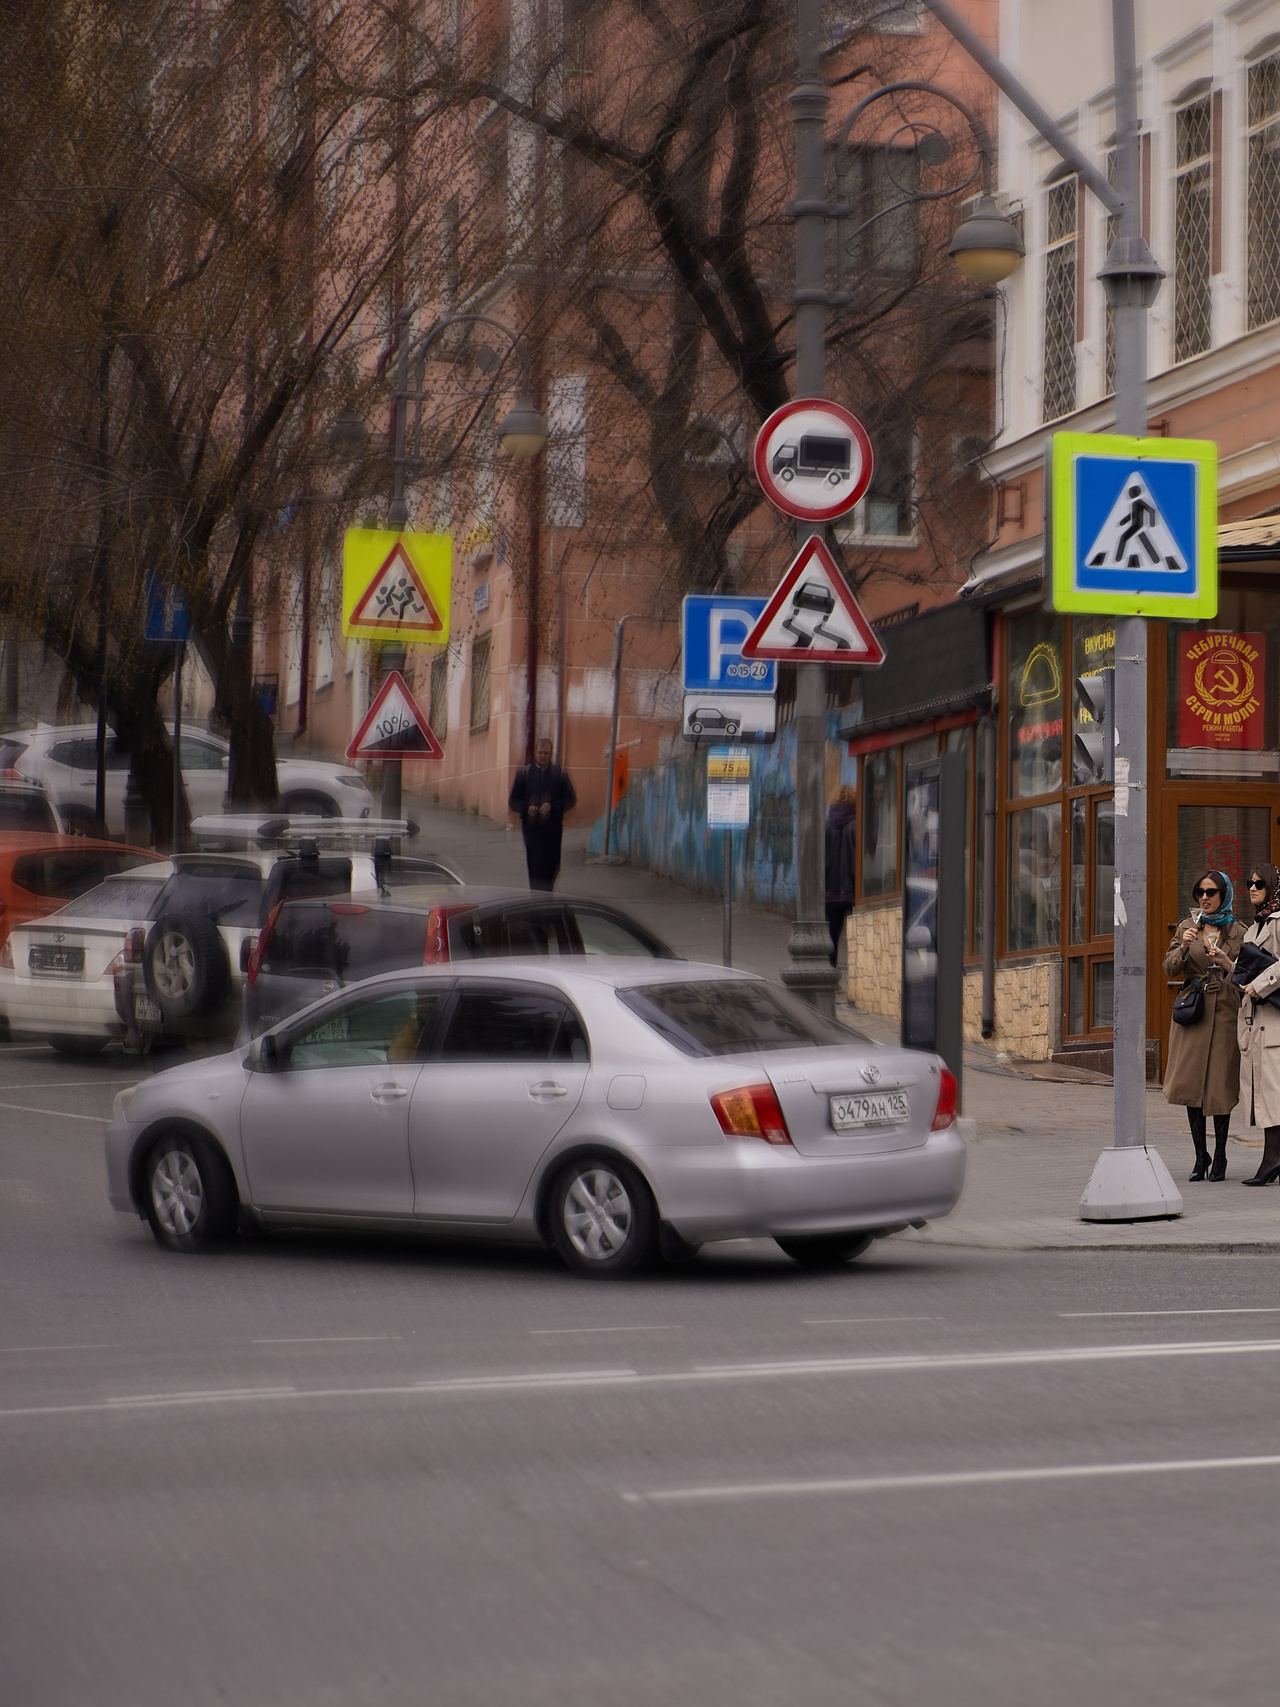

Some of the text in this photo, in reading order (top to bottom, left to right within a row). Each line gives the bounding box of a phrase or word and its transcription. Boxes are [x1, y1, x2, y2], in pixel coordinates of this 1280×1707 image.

[1186, 634, 1259, 662] ЧЕБУРЕЧНАЯ
[729, 665, 767, 677] 10 15 20
[1185, 695, 1260, 725] СЕРП И МОЛОТ
[376, 713, 409, 738] 10%
[1202, 724, 1244, 733] РЕЖИМ РАБОТЫ
[723, 763, 734, 772] 75
[888, 1095, 906, 1110] 125
